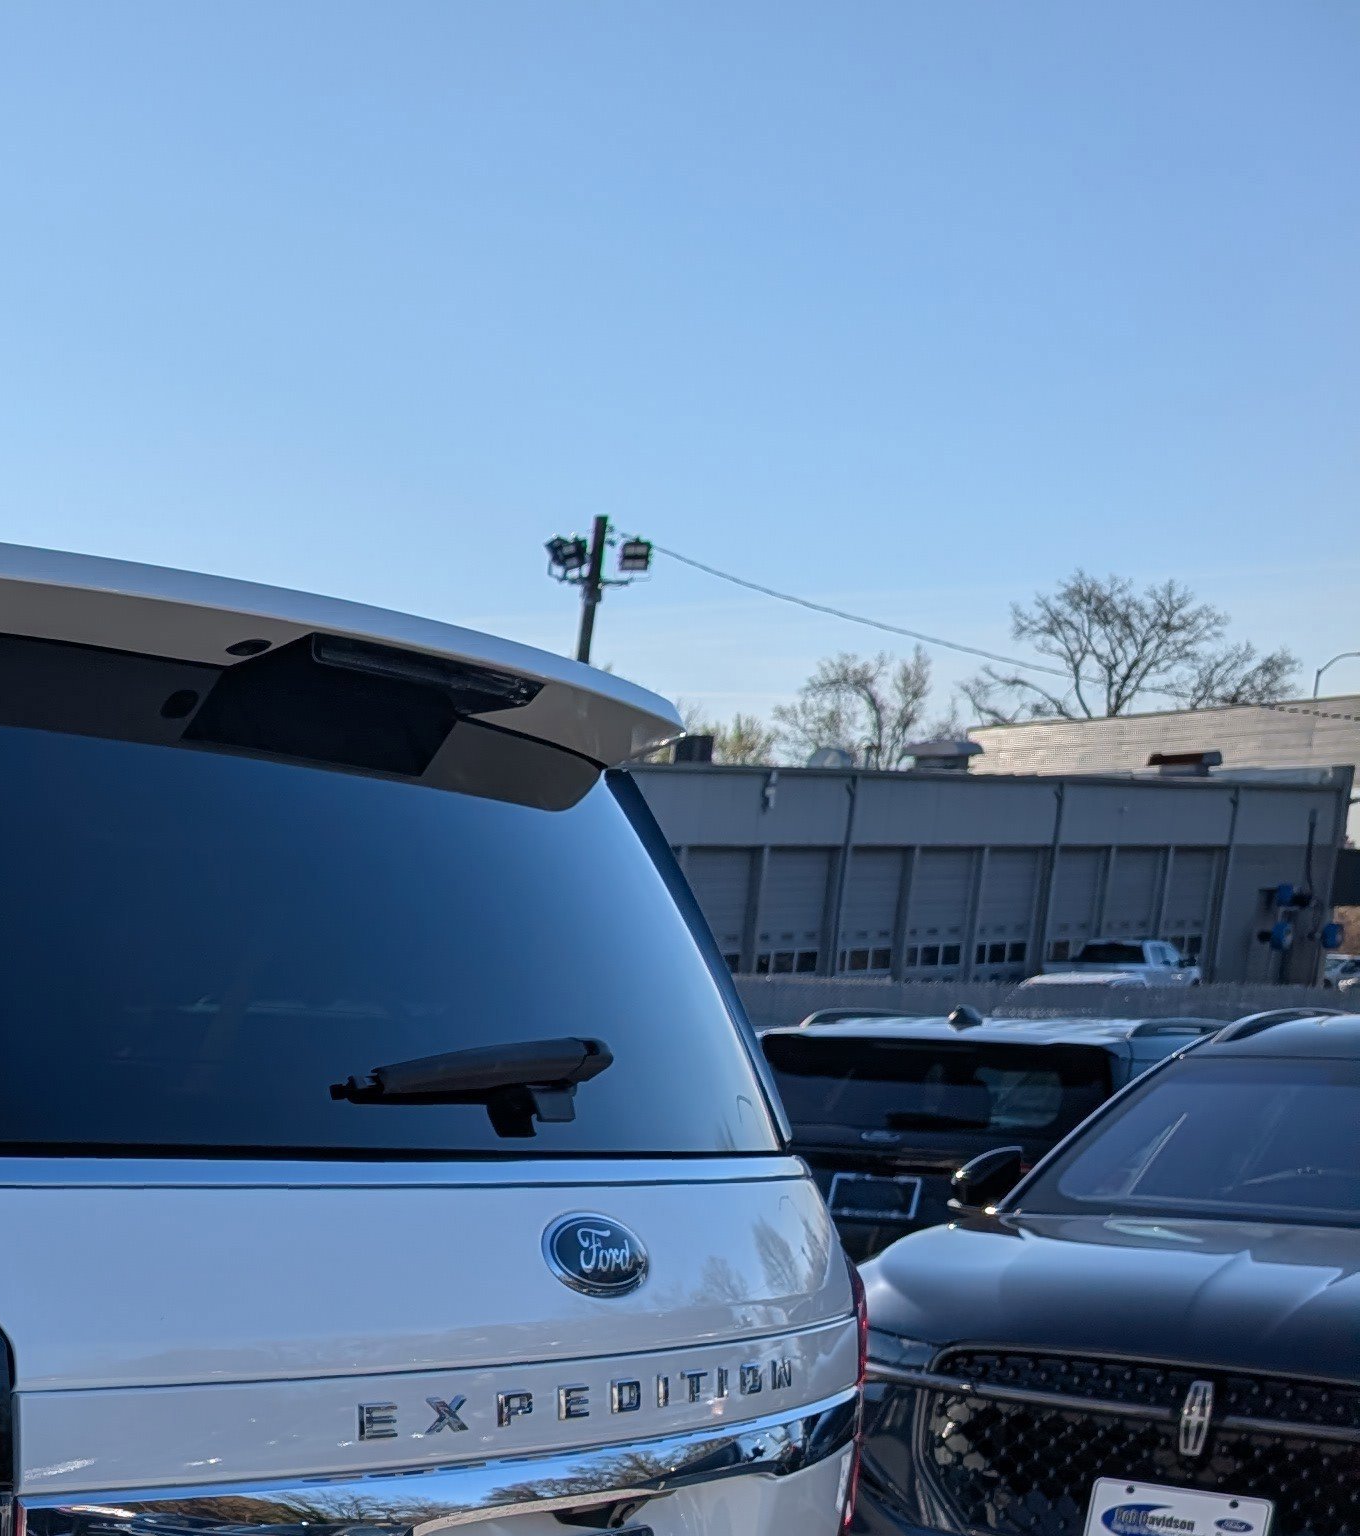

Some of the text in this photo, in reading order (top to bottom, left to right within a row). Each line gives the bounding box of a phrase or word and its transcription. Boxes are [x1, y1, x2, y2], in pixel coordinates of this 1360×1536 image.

[576, 1227, 634, 1275] Ford
[357, 1358, 793, 1442] EXPEDITION
[1140, 1510, 1195, 1532] Davidson
